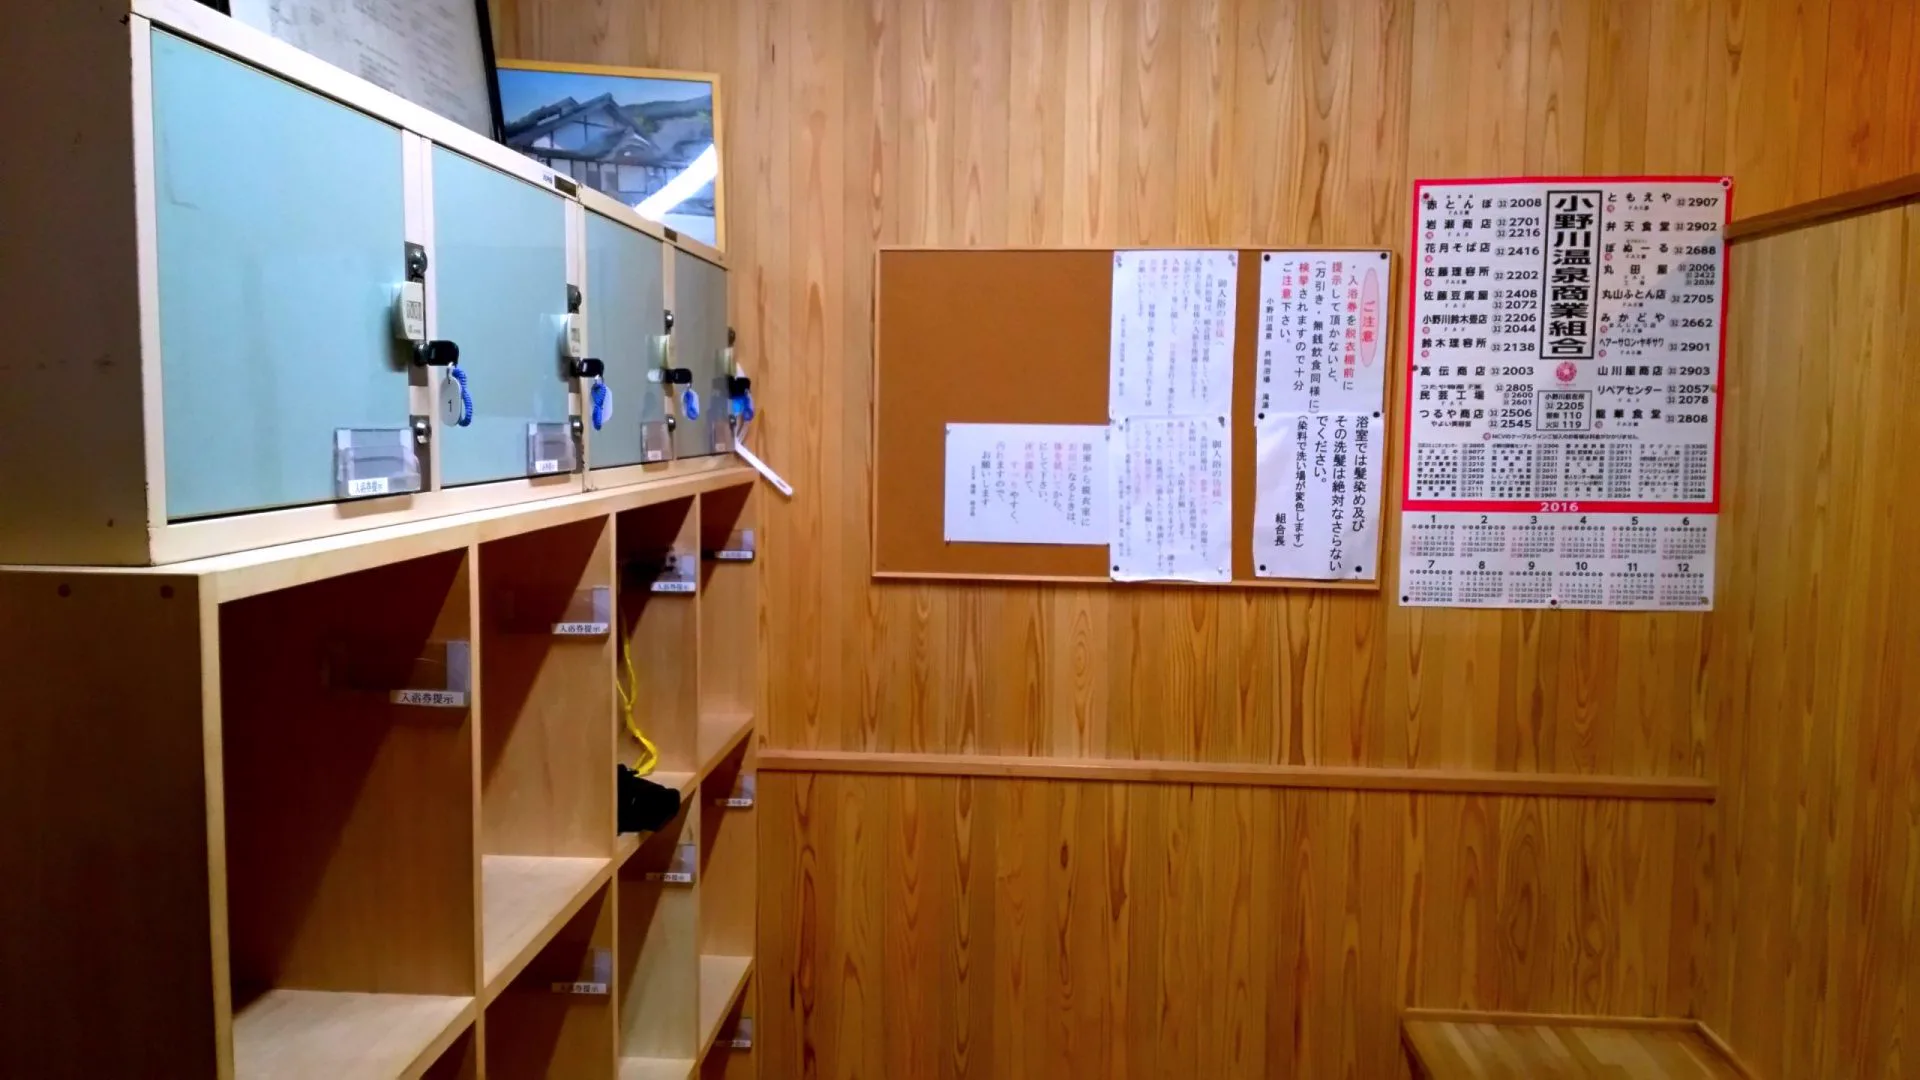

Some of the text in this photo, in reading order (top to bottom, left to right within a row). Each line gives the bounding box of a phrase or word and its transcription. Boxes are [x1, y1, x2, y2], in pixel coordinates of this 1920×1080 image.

[1608, 192, 1671, 202] ともえや
[1688, 198, 1718, 206] 2907
[1426, 198, 1492, 210] 赤とんぼ
[1510, 198, 1542, 208] 2008
[1426, 219, 1492, 230] 岩瀬商店
[1509, 217, 1540, 226] 2701
[1606, 221, 1670, 231] 弁天食堂
[1687, 222, 1717, 231] 2902
[1509, 228, 1541, 238] 2216
[1425, 242, 1491, 253] 花月そば店
[1508, 247, 1540, 256] 2416
[1686, 246, 1716, 255] 2688
[1689, 264, 1716, 272] 2006
[1424, 266, 1489, 277] 佐藤理容所
[1507, 271, 1539, 280] 2202
[1549, 195, 1594, 354] 小野川温泉商業組合
[1506, 289, 1537, 298] 2408
[1602, 289, 1666, 300] 丸山ふとん店
[1683, 294, 1714, 303] 2705
[1280, 261, 1293, 343] ご注意下さい。
[1505, 301, 1537, 309] 2072
[1362, 300, 1376, 343] ご注意
[1505, 313, 1536, 322] 2206
[1601, 313, 1665, 322] みかどや
[1682, 319, 1713, 327] 2662
[1294, 262, 1310, 391] 検挙されますので十分
[1505, 325, 1536, 333] 2044
[1421, 338, 1487, 348] 鈴木理容所
[1503, 342, 1535, 351] 2138
[1681, 343, 1710, 351] 2901
[1502, 367, 1534, 376] 2003
[1679, 367, 1710, 375] 2903
[1505, 384, 1533, 392] 2805
[1598, 385, 1662, 395] リペアセンター
[1678, 385, 1709, 393] 2057
[1678, 396, 1709, 404] 2078
[1556, 402, 1584, 410] 2205
[1420, 409, 1484, 419] つるや商店
[1501, 409, 1532, 417] 2506
[1677, 415, 1708, 423] 2808
[1501, 420, 1532, 428] 2545
[1314, 416, 1328, 483] でください。
[1352, 416, 1369, 532] 浴室では髪染め及び
[1330, 415, 1347, 571] その洗髪は絶対なさらない
[1541, 502, 1578, 511] 2016
[1431, 515, 1436, 523] 1
[1481, 515, 1488, 524] 2
[1531, 516, 1537, 524] 3
[1580, 516, 1587, 524] 4
[1632, 516, 1638, 525] 5
[1683, 517, 1689, 525] 6
[1275, 513, 1286, 546] 組合長
[1428, 560, 1435, 568] 7
[1479, 561, 1485, 569] 8
[1528, 561, 1535, 569] 9
[1576, 562, 1588, 570] 10
[1627, 563, 1637, 571] 11
[1678, 563, 1689, 572] 12
[560, 624, 600, 633] 入浴券提示
[401, 692, 454, 704] 入浴券提示
